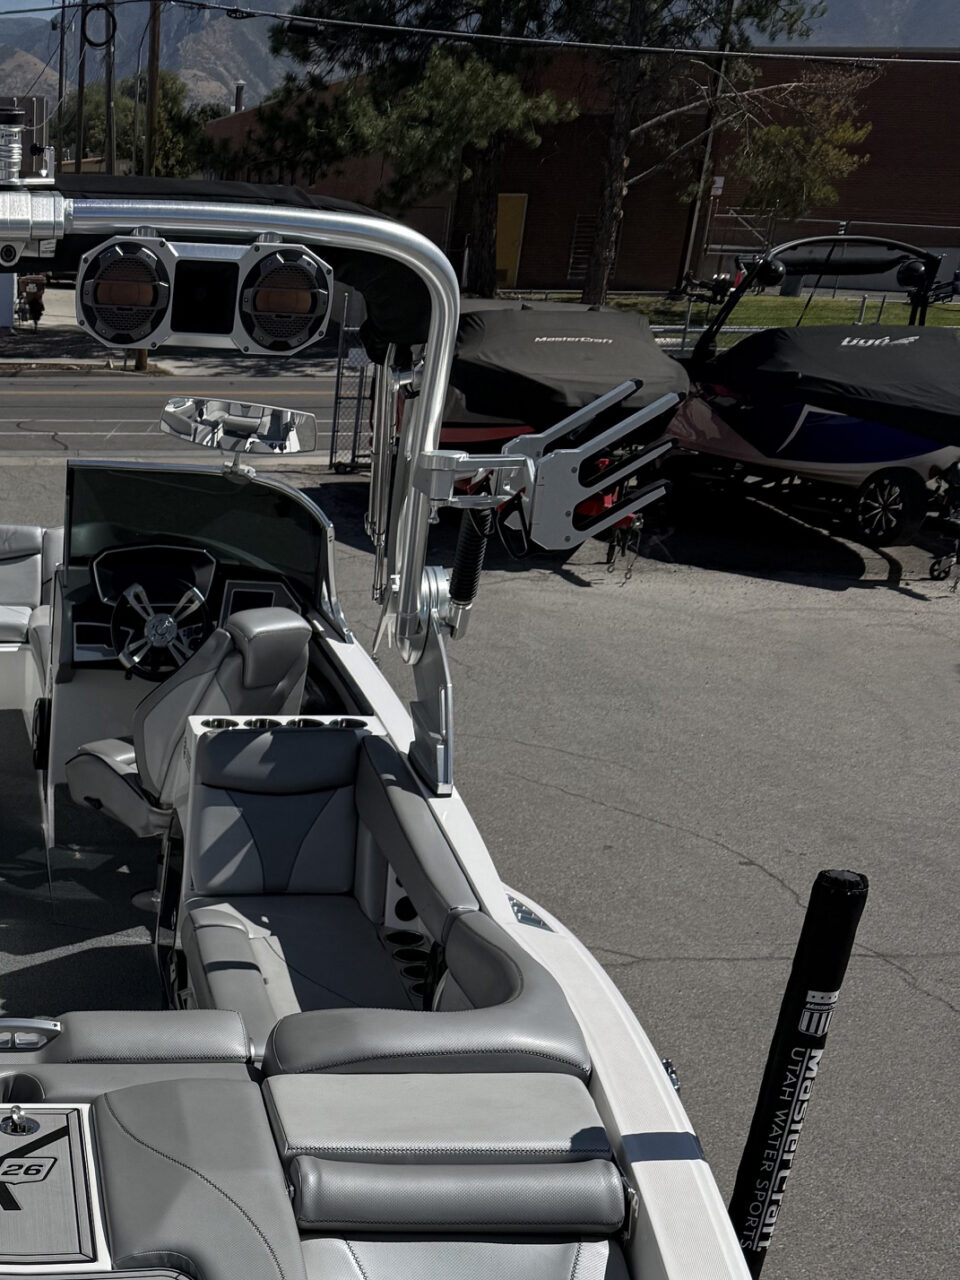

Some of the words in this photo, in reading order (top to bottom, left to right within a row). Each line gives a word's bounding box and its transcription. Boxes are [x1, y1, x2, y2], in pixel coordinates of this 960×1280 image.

[534, 335, 614, 345] MasterCraft
[779, 1046, 806, 1101] UTAH
[759, 1108, 789, 1172] WATER
[740, 1178, 770, 1249] SPORTS
